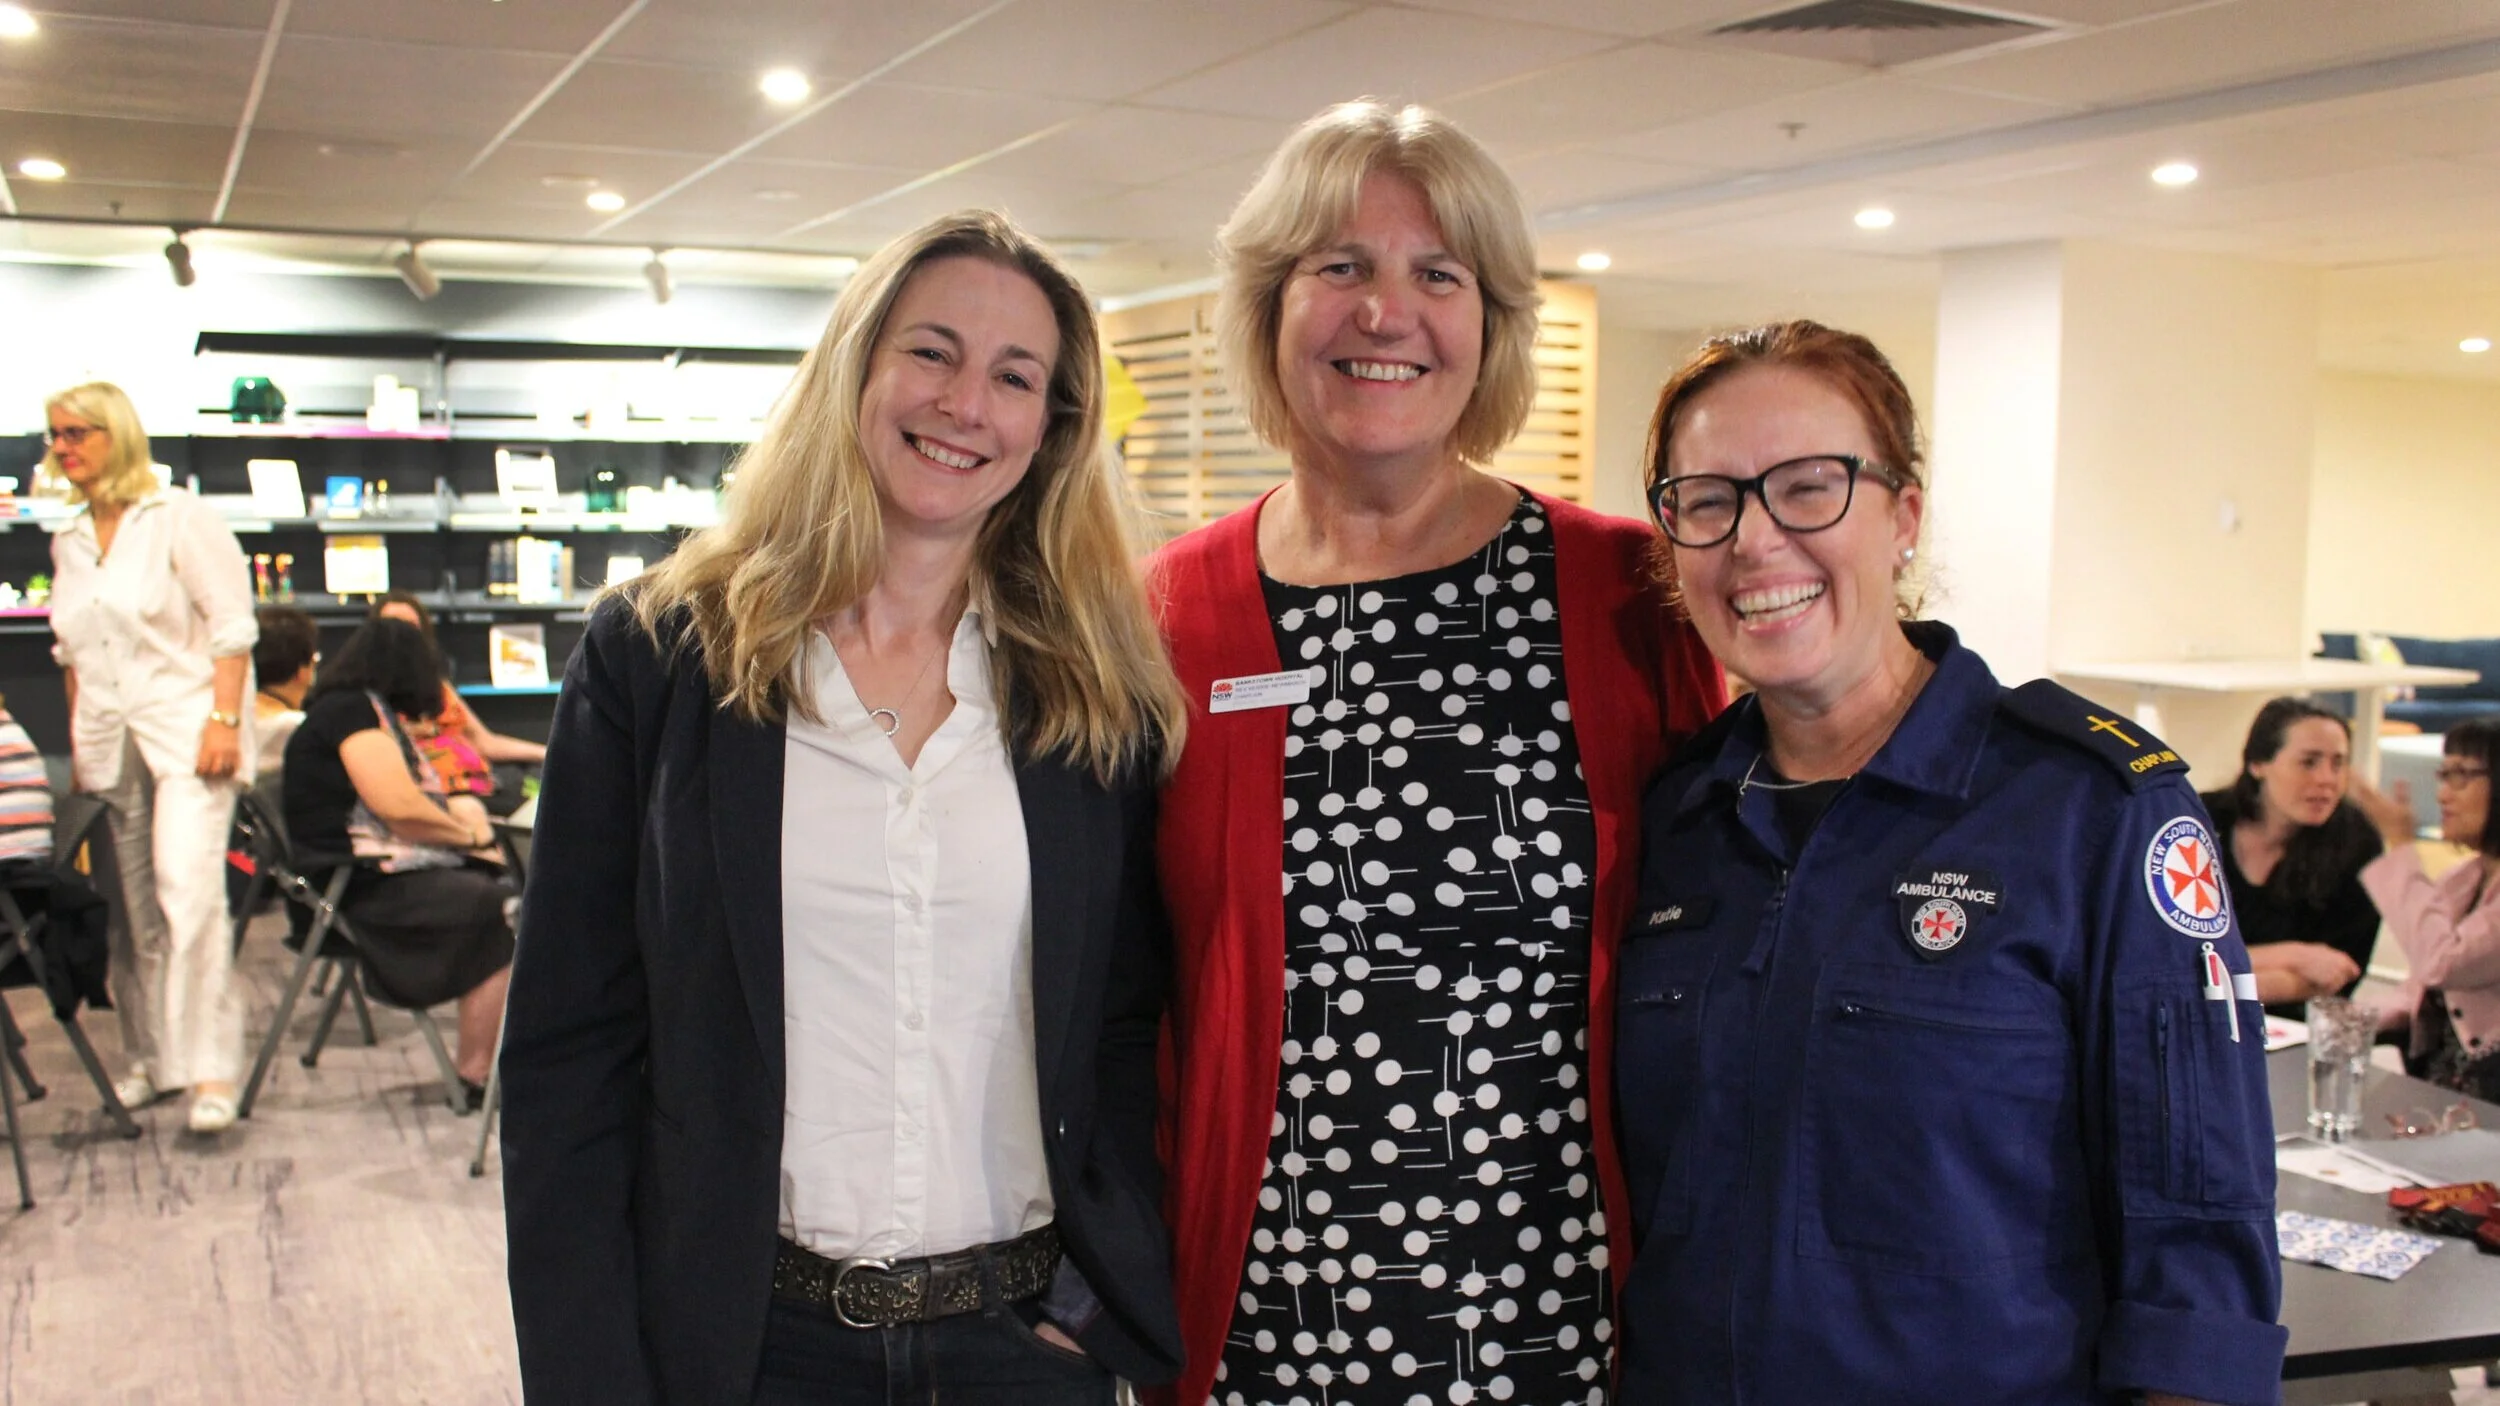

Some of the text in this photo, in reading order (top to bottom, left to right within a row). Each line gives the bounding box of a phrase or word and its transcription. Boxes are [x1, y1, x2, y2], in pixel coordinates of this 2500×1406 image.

[1212, 692, 1232, 700] NSW
[2151, 843, 2167, 875] NEW
[2164, 824, 2198, 843] SOUTH
[1931, 871, 1969, 886] NSW
[1897, 882, 1997, 905] AMBULANCE
[1648, 904, 1682, 925] Katie
